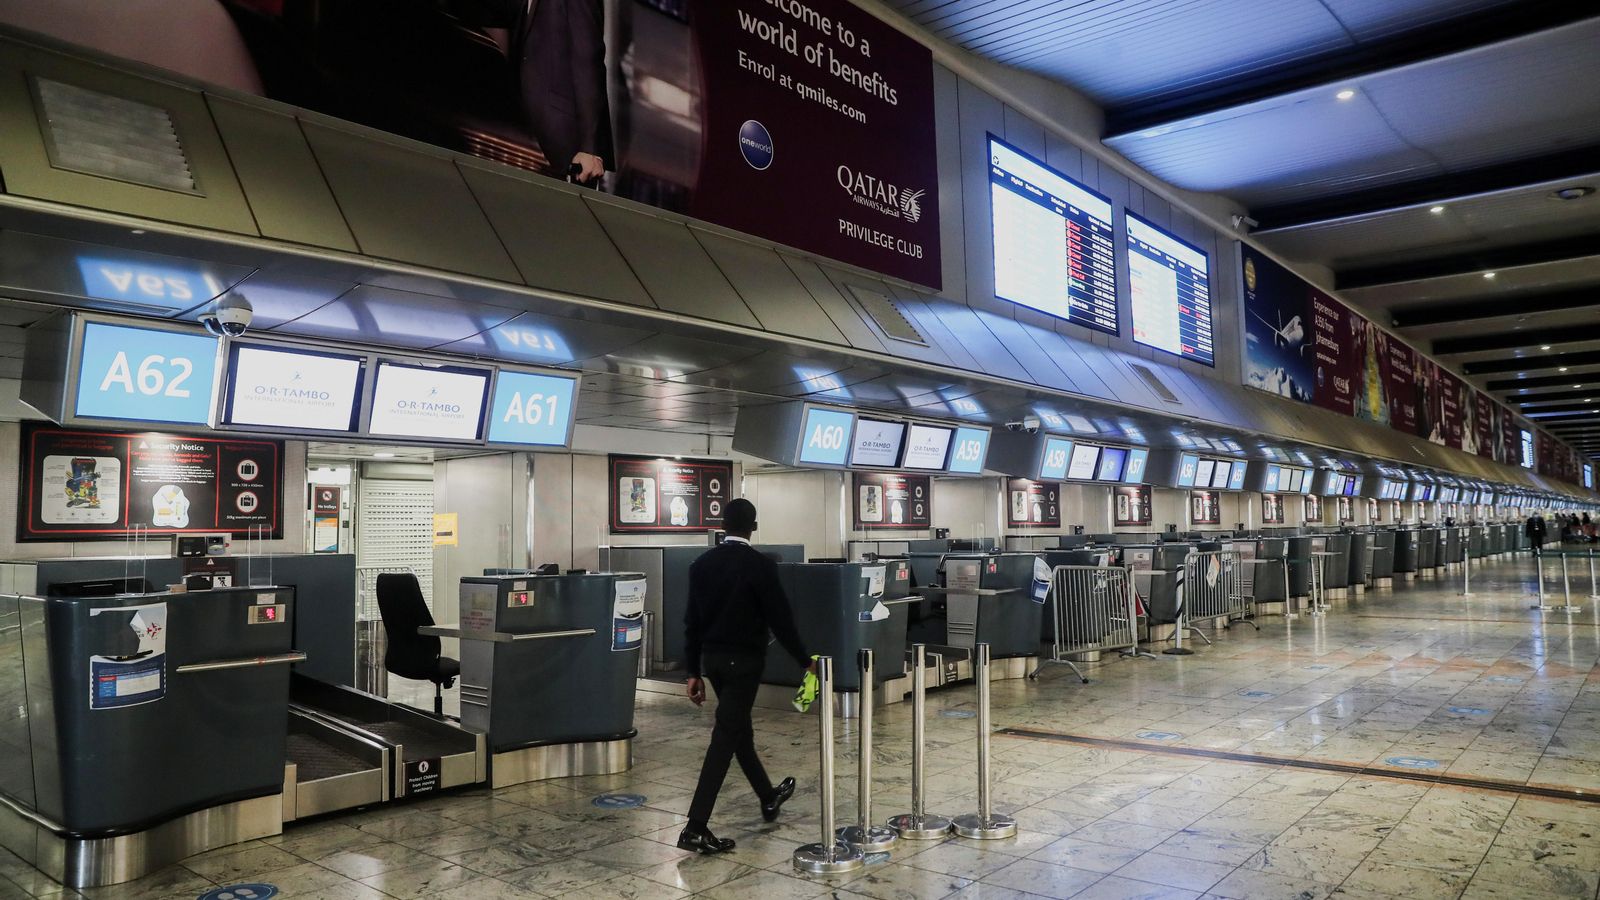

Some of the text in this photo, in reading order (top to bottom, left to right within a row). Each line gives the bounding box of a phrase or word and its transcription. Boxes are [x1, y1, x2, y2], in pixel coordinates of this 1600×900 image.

[765, 0, 872, 58] come to a
[737, 9, 899, 106] world of benefits
[737, 49, 867, 124] Enrol at qmiles.com
[741, 136, 772, 154] oneworld
[837, 165, 900, 208] QATAR
[853, 194, 880, 212] AIRWAYS
[838, 218, 924, 260] PRIVILEGE CLUB
[99, 351, 193, 399] A62
[503, 391, 558, 426] A61
[181, 443, 205, 452] Notice
[809, 423, 845, 450] A60
[956, 439, 981, 462] A59
[1046, 448, 1066, 468] A58
[1127, 458, 1143, 474] A57
